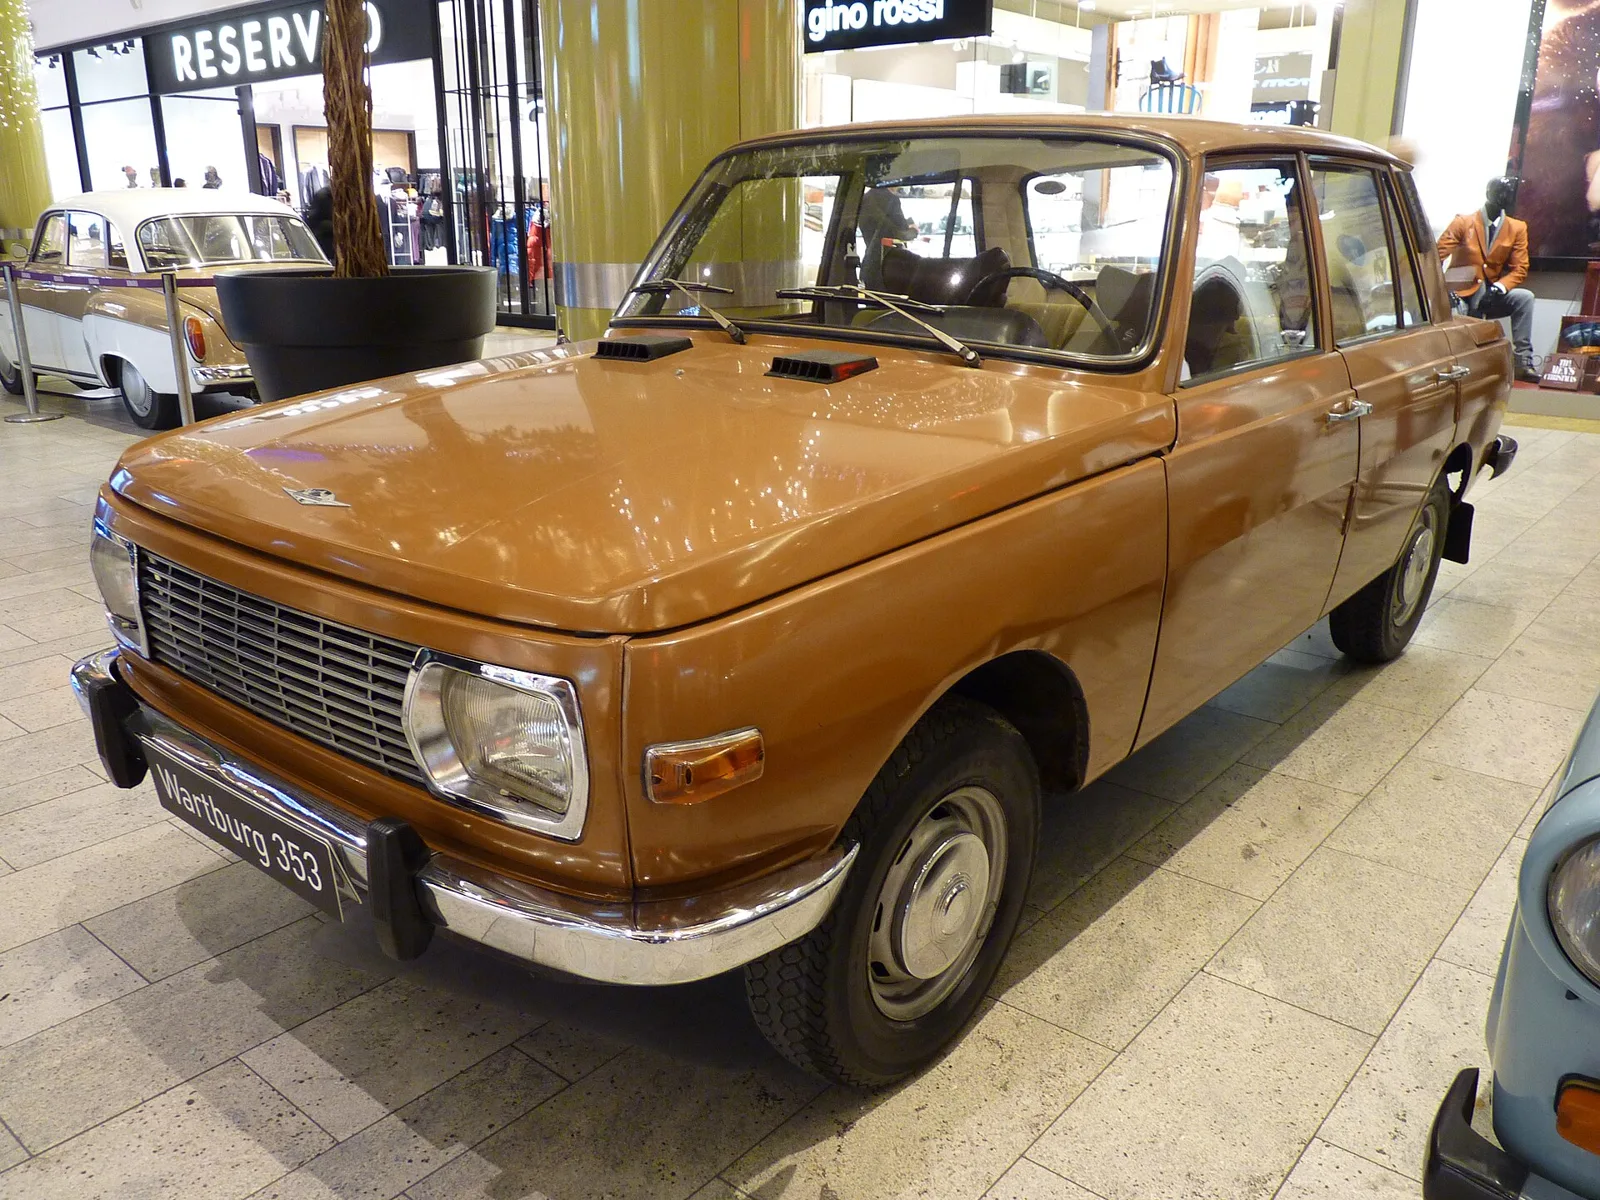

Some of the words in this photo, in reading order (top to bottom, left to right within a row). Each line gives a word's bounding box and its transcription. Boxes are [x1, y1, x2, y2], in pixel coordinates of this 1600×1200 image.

[171, 1, 381, 82] RESERVD
[808, 0, 868, 42] gino
[872, 0, 944, 27] rossi
[156, 763, 269, 868] Wartburg
[271, 832, 323, 892] 353
